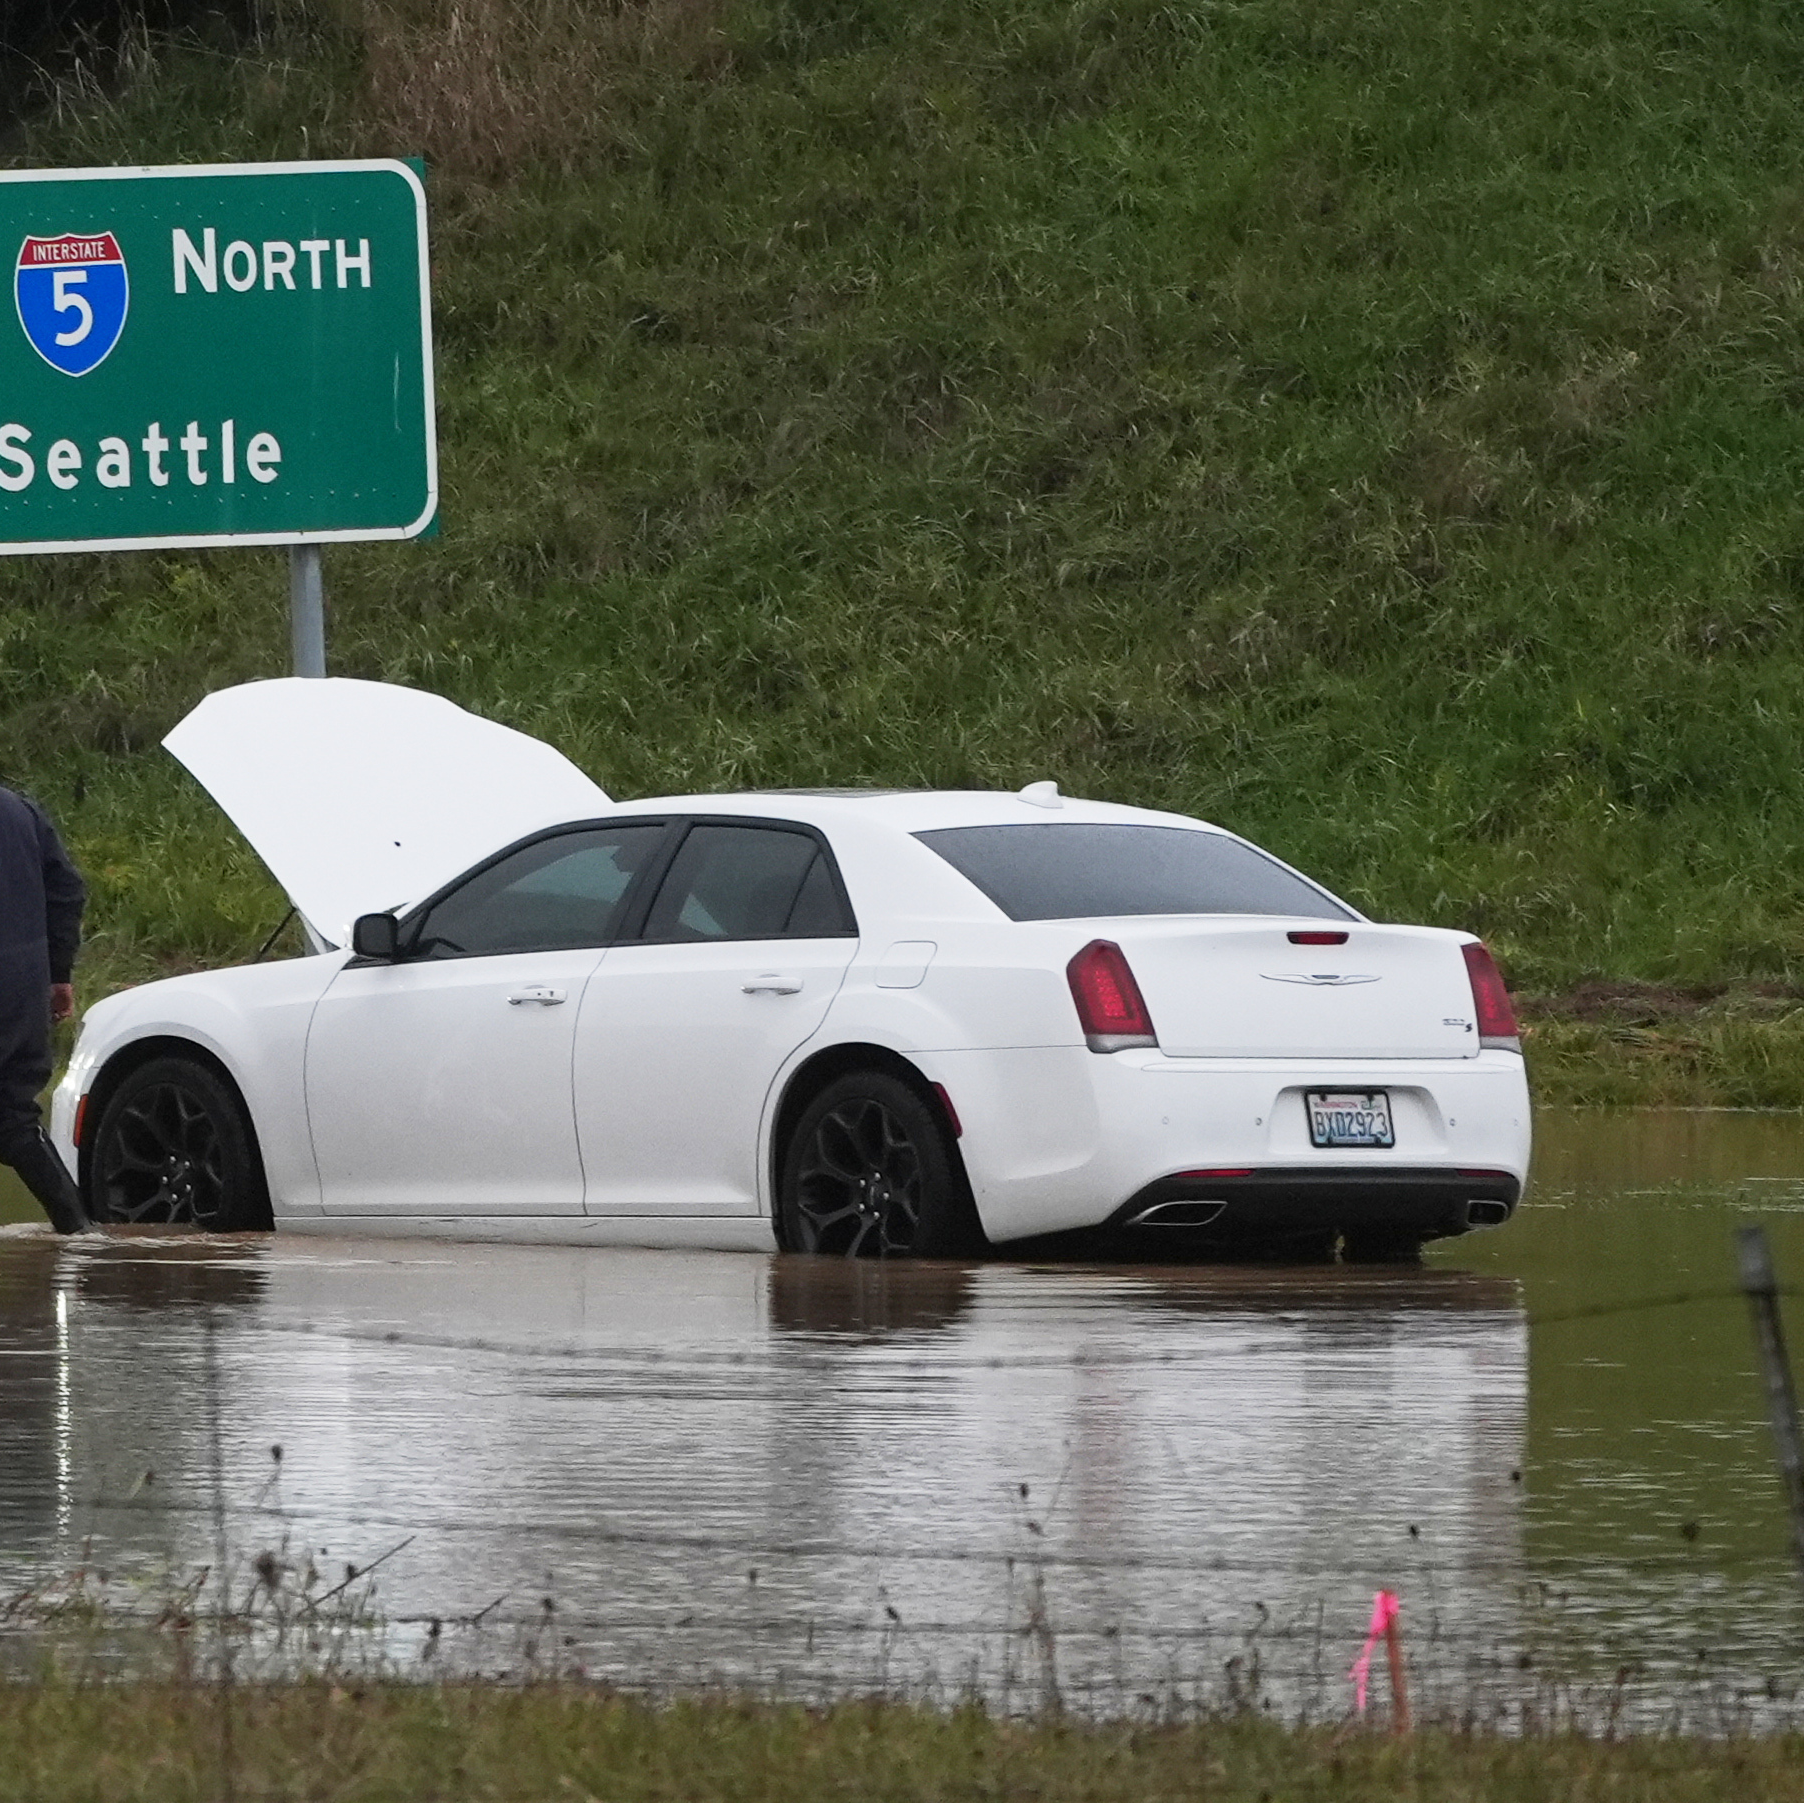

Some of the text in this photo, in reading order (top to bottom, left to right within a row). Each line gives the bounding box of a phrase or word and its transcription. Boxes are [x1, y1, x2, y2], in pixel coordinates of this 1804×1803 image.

[33, 241, 107, 262] INTERSTATE
[172, 227, 372, 295] NORTH
[53, 270, 93, 347] 5
